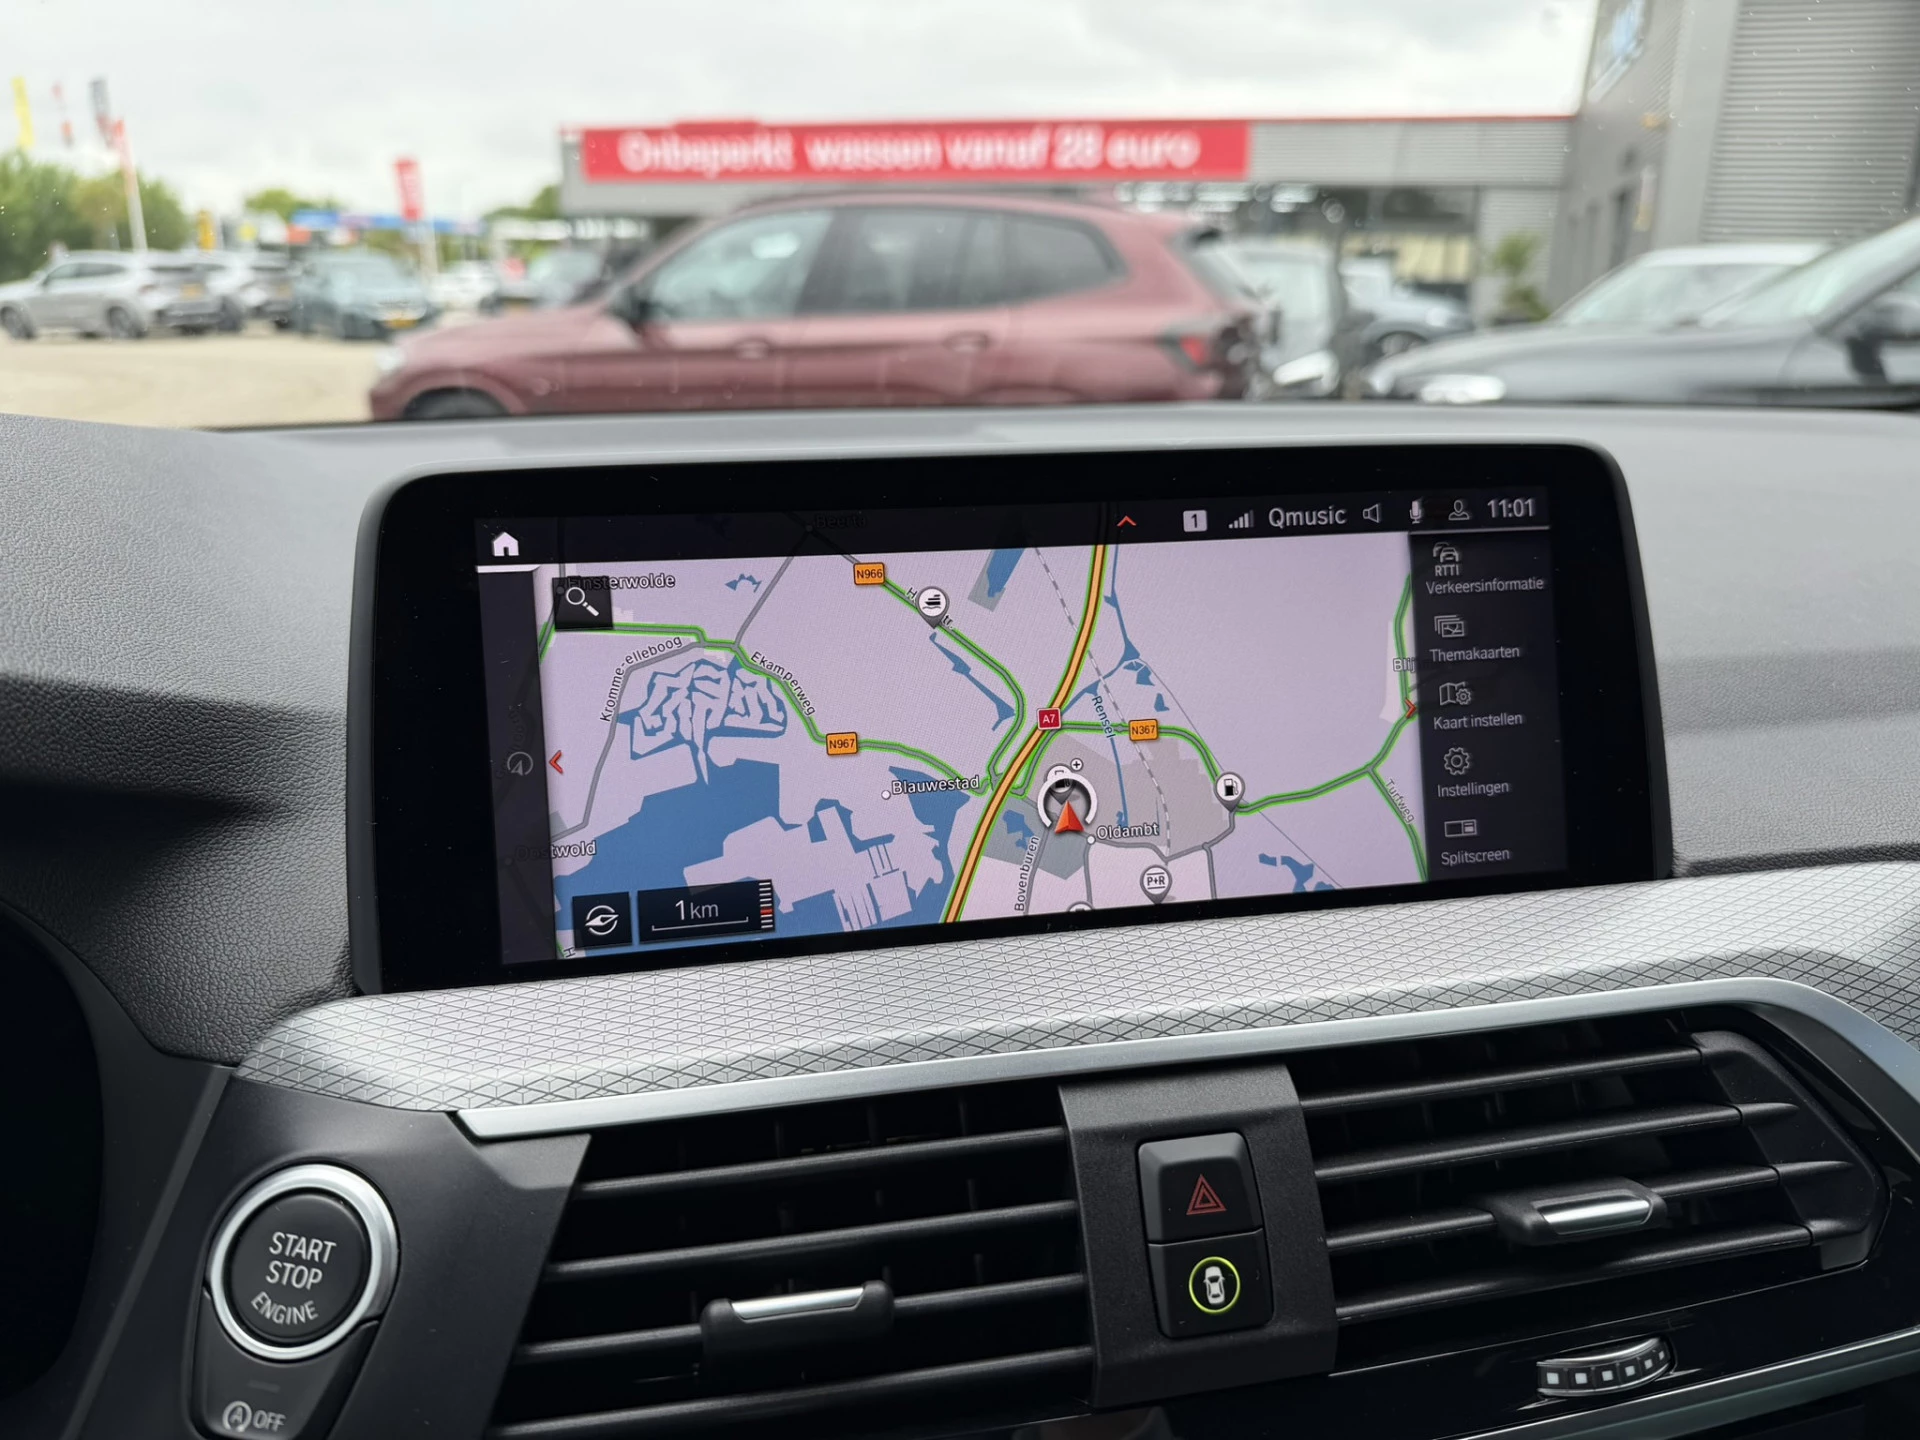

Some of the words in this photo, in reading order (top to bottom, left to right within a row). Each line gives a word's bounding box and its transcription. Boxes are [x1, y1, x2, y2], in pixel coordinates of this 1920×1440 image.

[804, 134, 942, 171] wassen
[944, 124, 1050, 170] vanaf
[1106, 129, 1201, 169] euro
[1268, 506, 1348, 529] Qmusic
[1487, 498, 1536, 520] 11:01
[856, 566, 883, 580] N966
[1434, 564, 1460, 577] RTTI
[1426, 576, 1545, 595] Verkeersinformatie
[1429, 644, 1520, 662] Themakaarten
[599, 635, 683, 722] Kromme-elleboog
[749, 651, 817, 717] Ekamperweg
[1042, 713, 1056, 725] A7
[1433, 715, 1468, 730] Kaart
[1471, 713, 1523, 728] instellen
[1131, 724, 1156, 736] N367
[828, 737, 856, 751] N967
[891, 775, 980, 795] Blauwestad
[1437, 781, 1510, 797] Instellingen
[1384, 779, 1415, 824] Turfweg
[1096, 822, 1159, 840] Oldambt
[1441, 849, 1510, 866] Splitscreen
[1014, 836, 1040, 912] Bovenburen
[1146, 875, 1166, 888] P+R
[269, 1231, 336, 1264] START
[265, 1261, 323, 1290] STOP
[251, 1291, 319, 1325] ENGINE
[253, 1410, 286, 1431] OFF
